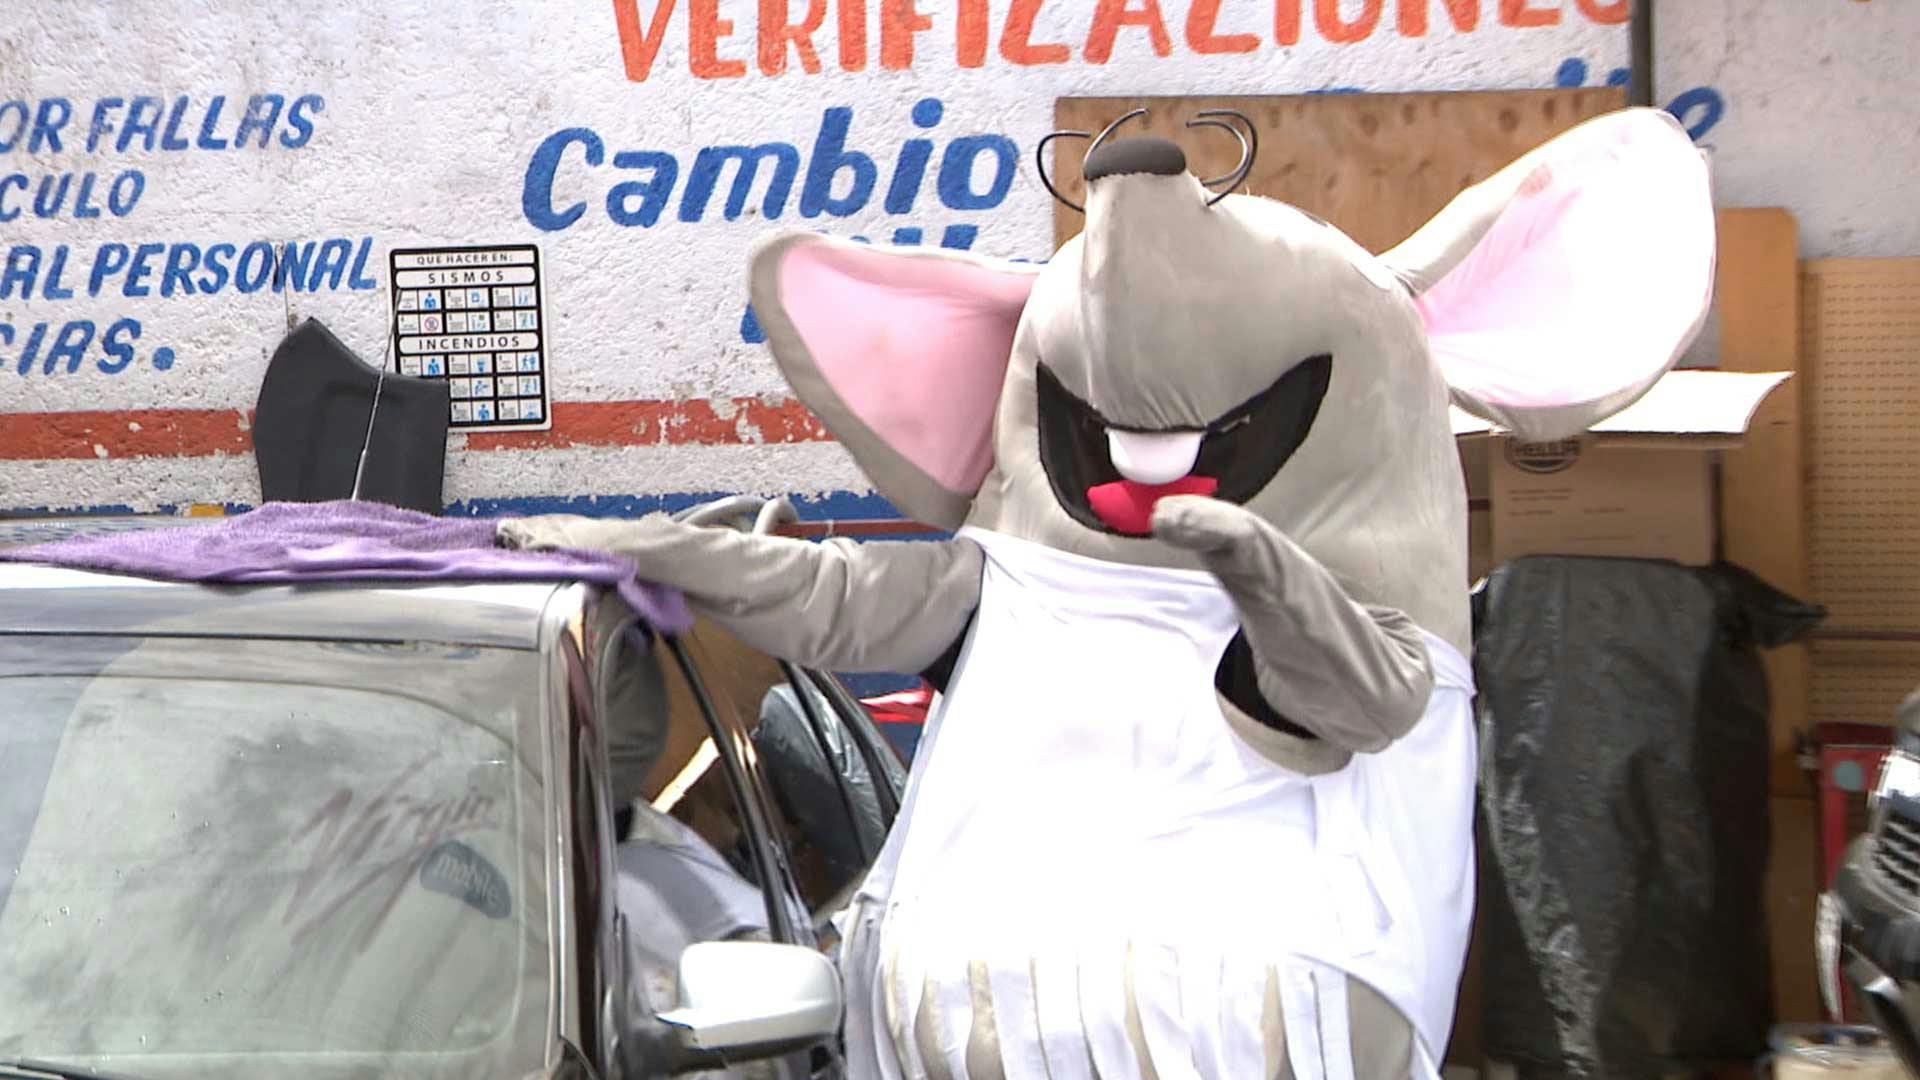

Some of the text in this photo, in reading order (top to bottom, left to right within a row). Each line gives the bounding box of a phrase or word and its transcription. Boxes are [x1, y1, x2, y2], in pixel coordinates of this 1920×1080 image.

[613, 0, 1631, 82] VERIFICACI
[86, 93, 325, 152] FALLAS
[521, 98, 1020, 232] Cambio
[0, 170, 146, 222] CULO
[88, 236, 377, 299] PERSONAL
[417, 256, 442, 265] QUE
[446, 254, 489, 264] HACER
[428, 270, 504, 284] SISMOS
[419, 336, 520, 350] INCENDIOS
